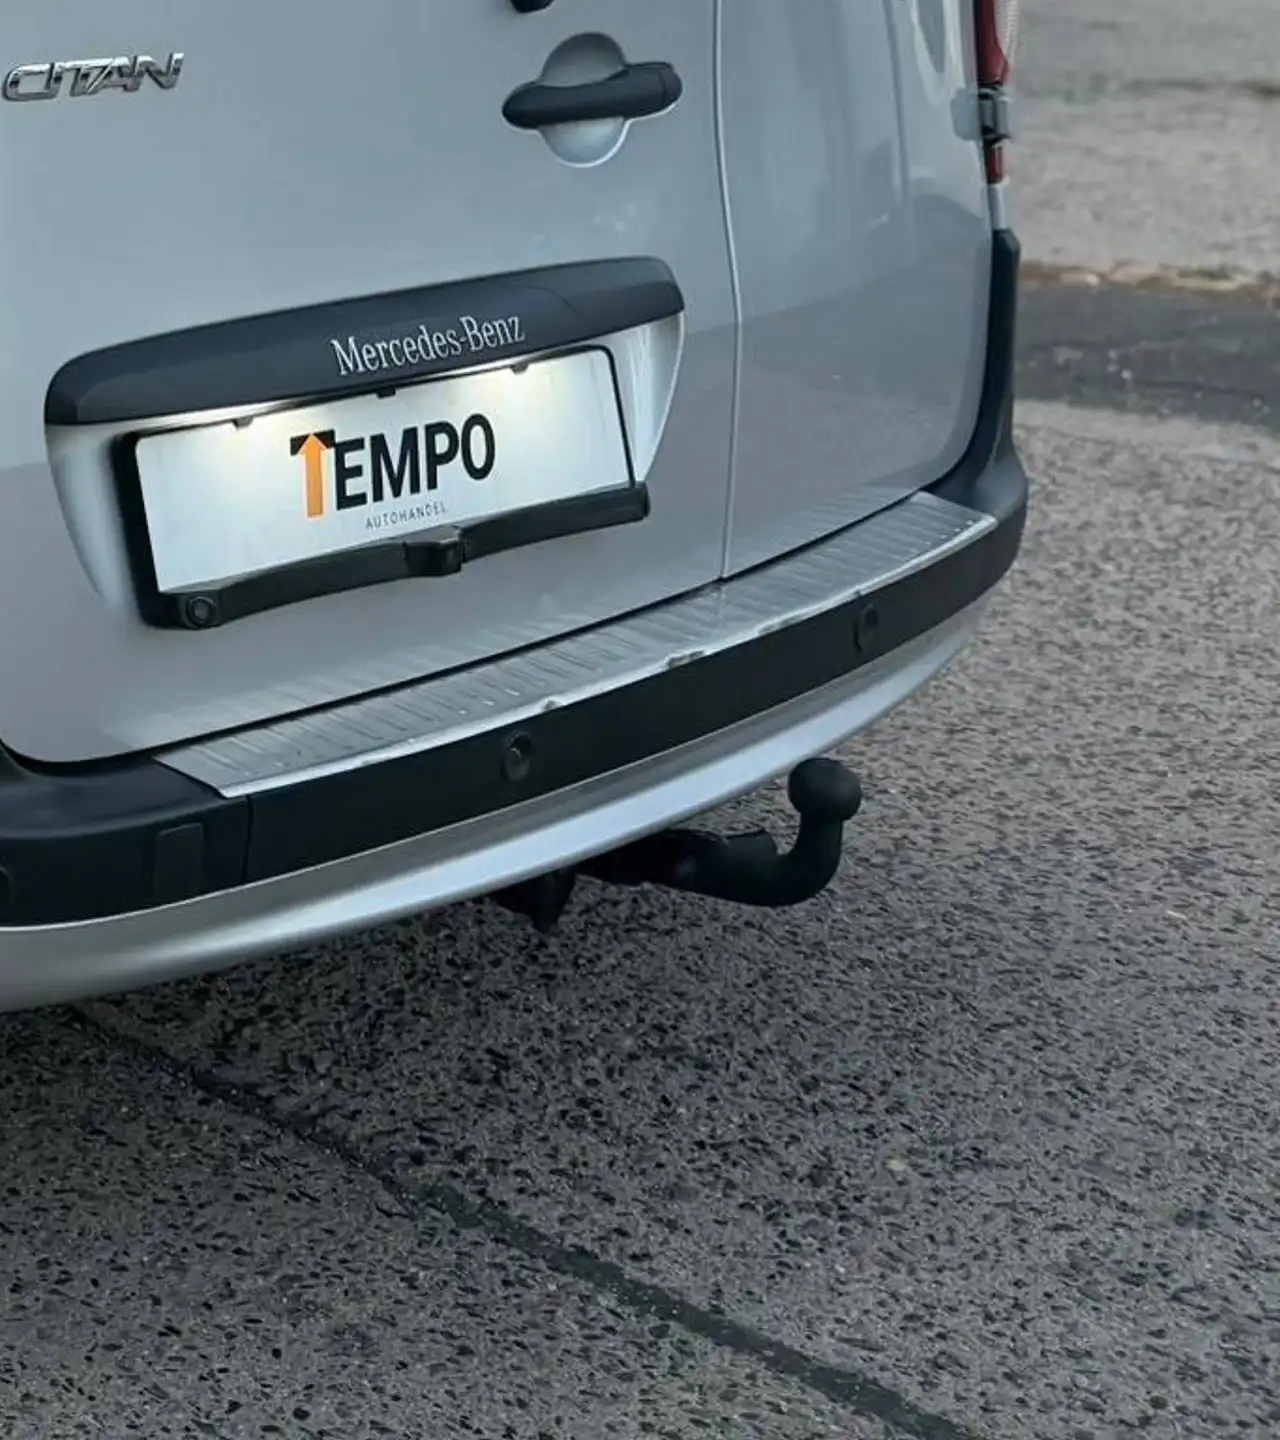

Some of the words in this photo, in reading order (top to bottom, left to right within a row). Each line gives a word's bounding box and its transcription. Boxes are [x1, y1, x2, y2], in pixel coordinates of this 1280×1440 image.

[2, 52, 185, 101] CITAN
[330, 316, 525, 376] Mercedes-Benz
[290, 413, 496, 519] TEMPO
[365, 502, 448, 530] AUTOHANDEL
